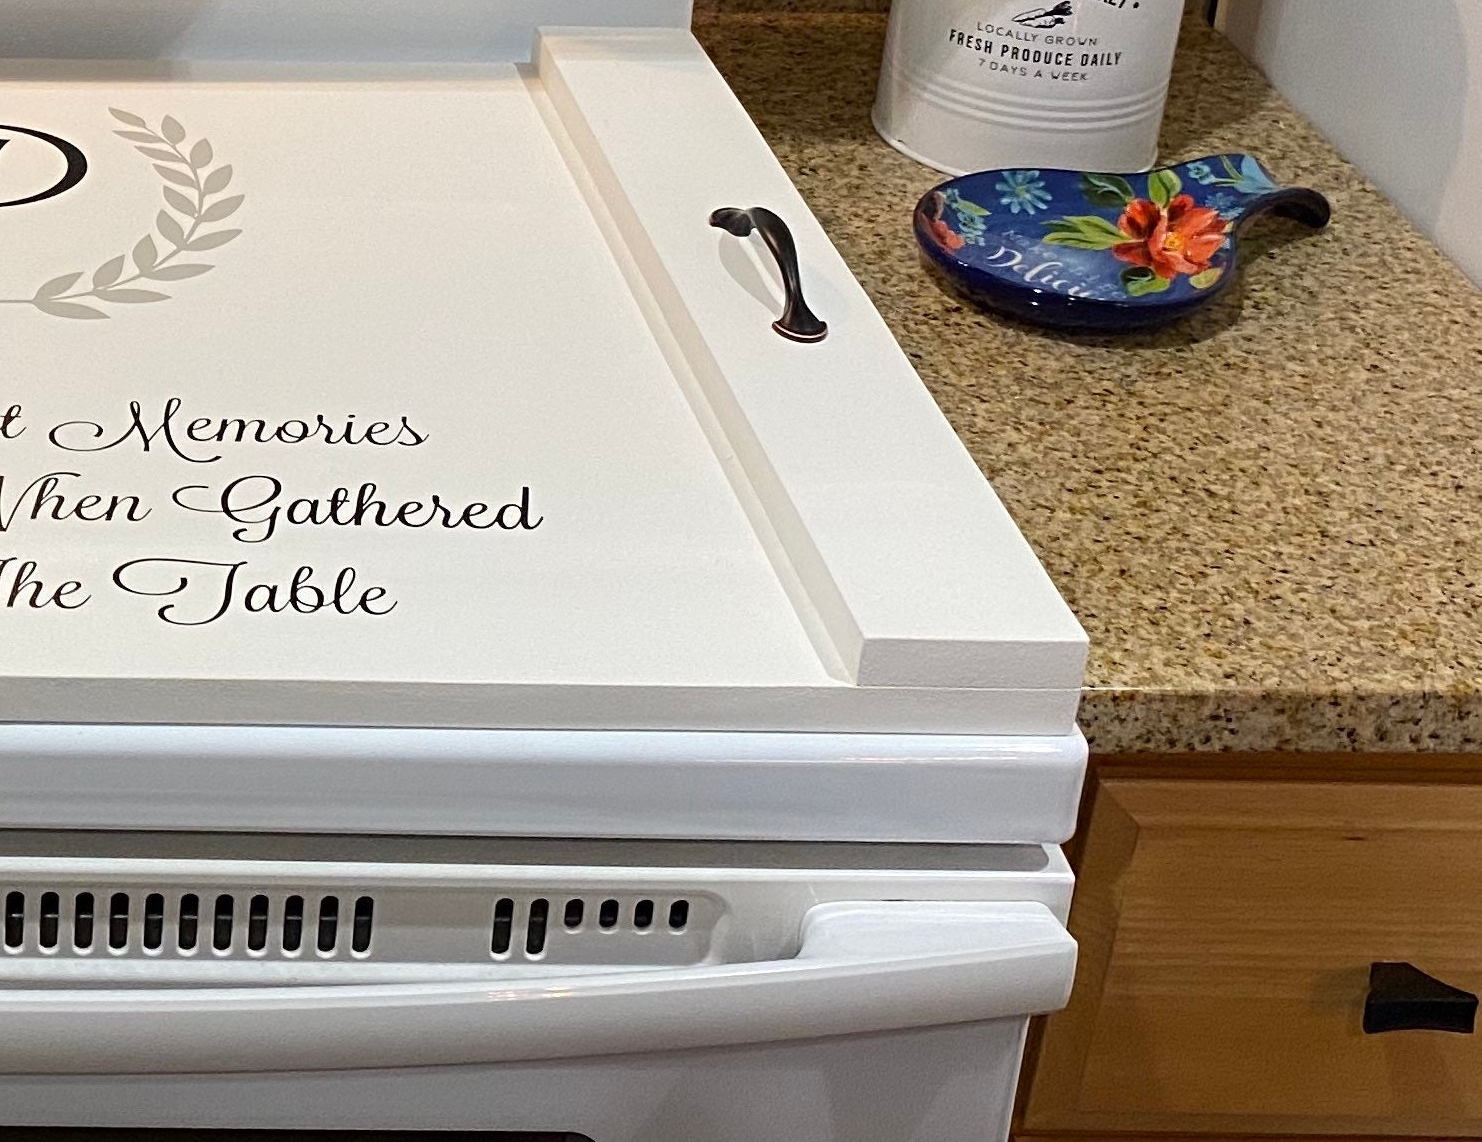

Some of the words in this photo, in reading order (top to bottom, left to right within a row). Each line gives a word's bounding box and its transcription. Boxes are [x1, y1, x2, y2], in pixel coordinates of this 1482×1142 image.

[948, 28, 993, 55] FRESH
[1000, 43, 1073, 67] PRODUCE
[1079, 51, 1122, 68] DAILY
[976, 21, 1039, 43] LOCALLY
[1044, 34, 1098, 47] GROWN
[988, 60, 1028, 77] DAYS
[1033, 69, 1043, 79] A
[1051, 71, 1089, 82] WEEK
[48, 397, 429, 463] Memories
[171, 474, 545, 544] Gathered
[111, 557, 398, 627] Table
